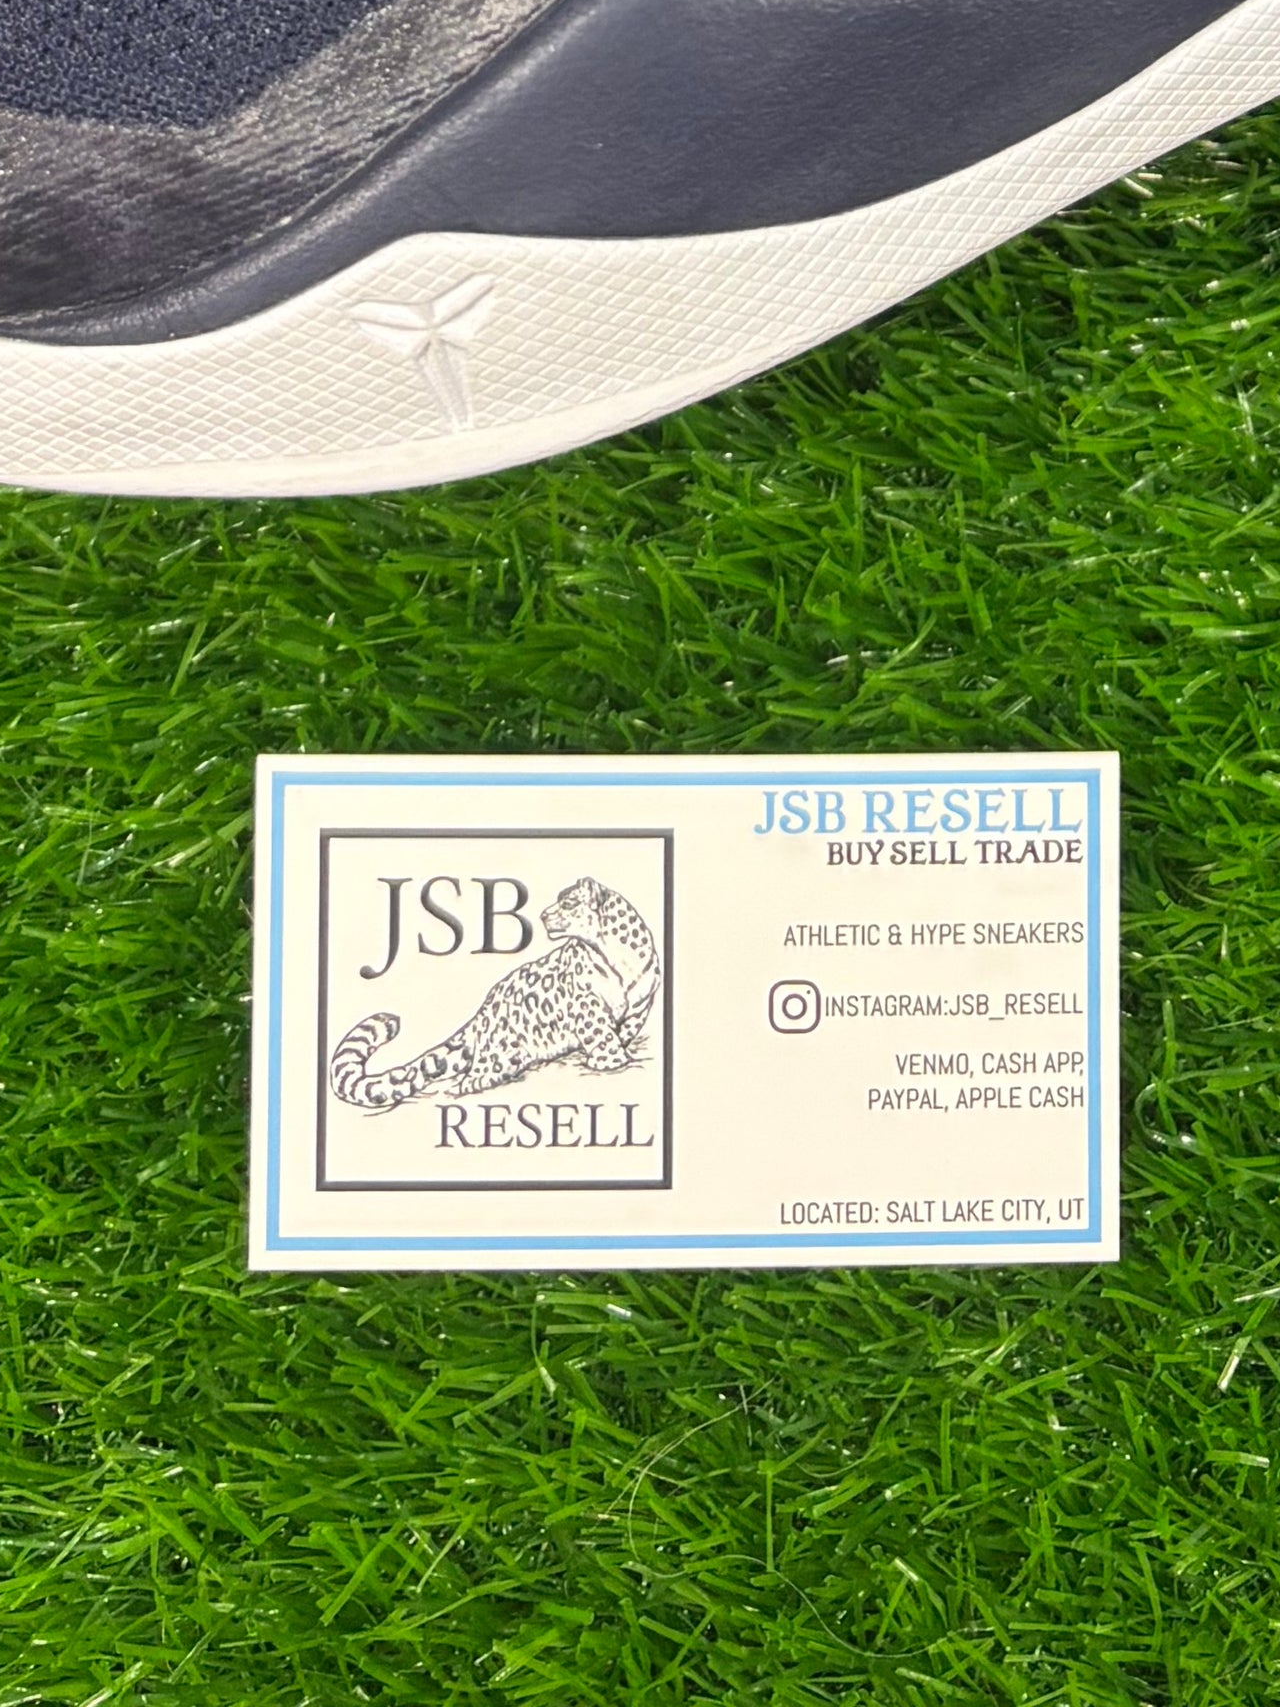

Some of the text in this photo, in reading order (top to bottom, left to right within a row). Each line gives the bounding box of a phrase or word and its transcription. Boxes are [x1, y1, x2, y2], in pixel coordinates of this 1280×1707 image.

[754, 788, 1081, 835] JSB RESELL
[827, 838, 1084, 866] BUY SELL TRADE
[359, 875, 535, 980] JSB
[783, 921, 1085, 947] ATHLETIC & HYPE SNEAKERS
[825, 992, 1084, 1021] INSTAGRAM:JSB_RESELL
[895, 1052, 974, 1079] VENMO,
[981, 1051, 1037, 1075] CASH
[868, 1085, 1084, 1113] PAYPAL, APPLE CASH
[434, 1103, 655, 1149] RESELL
[780, 1197, 1085, 1225] LOCATED: SALT LAKE CITY, UT
